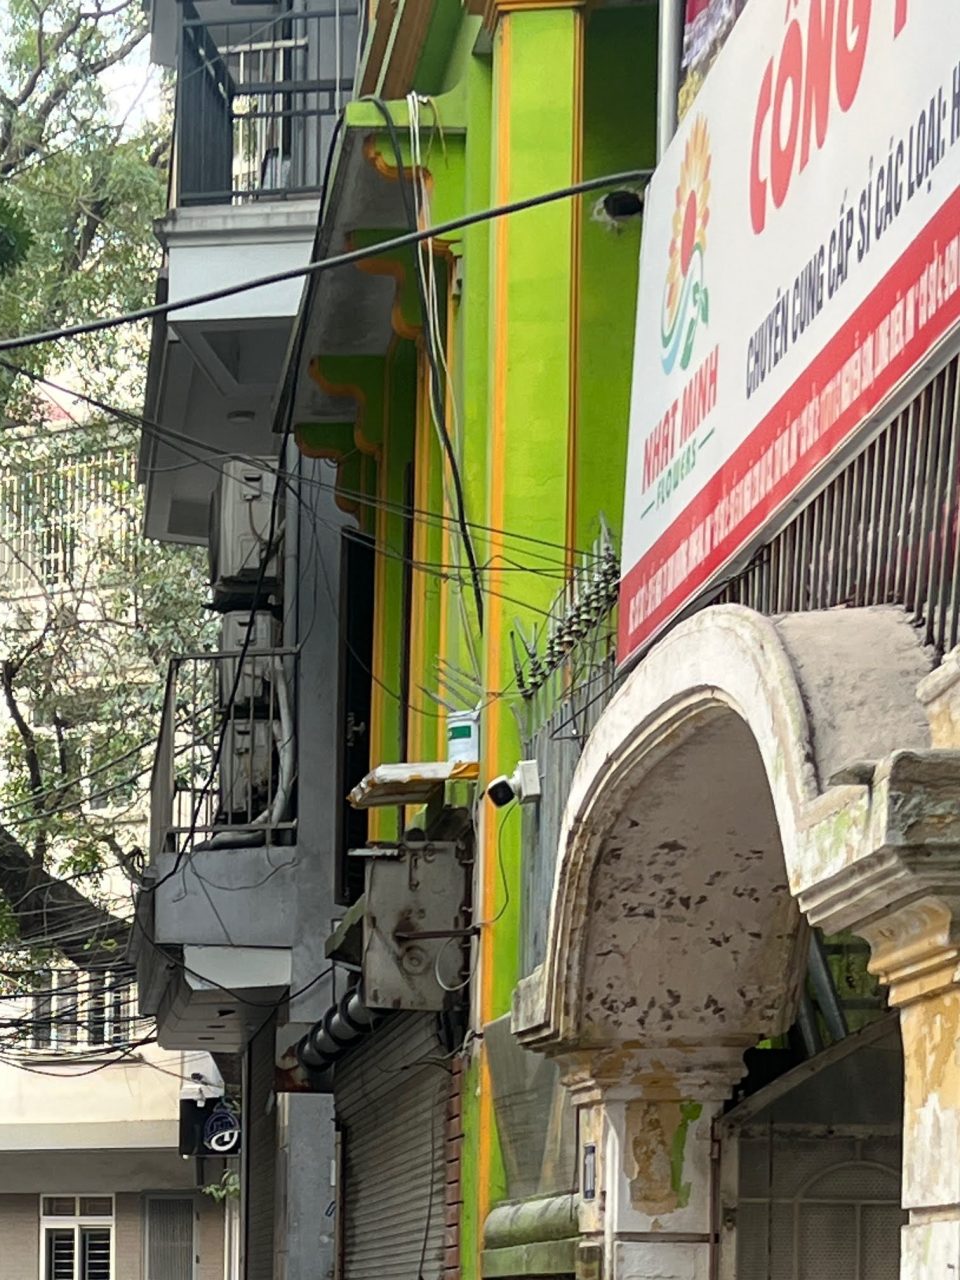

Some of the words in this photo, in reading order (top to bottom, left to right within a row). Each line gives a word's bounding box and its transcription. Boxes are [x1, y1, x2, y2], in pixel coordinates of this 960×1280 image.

[746, 286, 790, 400] CHUYÊN
[792, 245, 824, 344] CUNG
[828, 187, 854, 300] CẤP
[875, 136, 904, 240] CÁC
[680, 343, 719, 448] MINH
